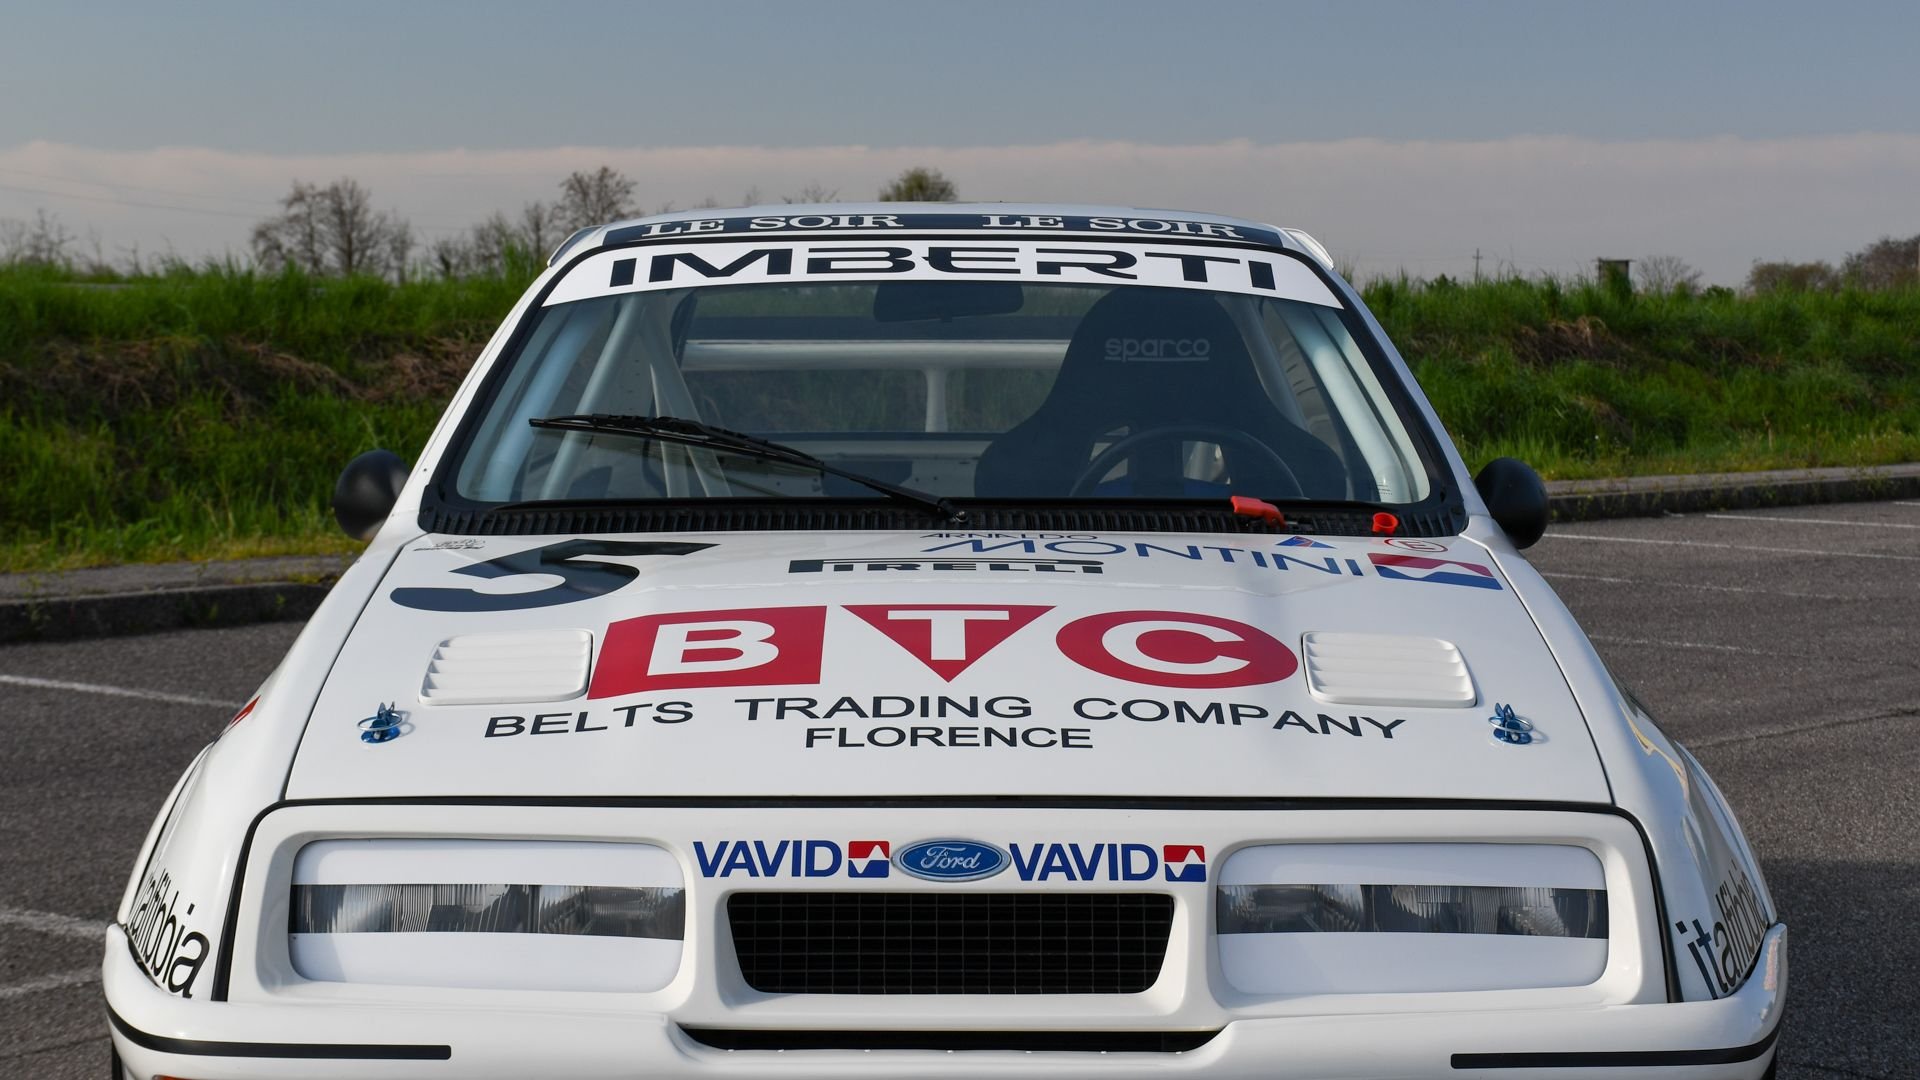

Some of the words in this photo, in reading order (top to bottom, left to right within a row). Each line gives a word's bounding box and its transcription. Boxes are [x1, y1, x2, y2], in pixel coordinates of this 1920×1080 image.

[642, 219, 724, 238] LE
[750, 215, 904, 230] SOIR
[982, 215, 1064, 228] LE
[1089, 218, 1244, 239] SOIR
[609, 246, 1276, 290] IMBERTI
[1105, 338, 1210, 362] sparco
[788, 557, 1104, 574] PIRELLI
[920, 539, 1364, 577] MONTINI
[389, 539, 721, 612] 5
[484, 701, 694, 738] BELTS
[735, 696, 1032, 720] TRADING
[1073, 697, 1406, 740] COMPANY
[806, 727, 1093, 748] FLORENCE
[692, 840, 842, 878] VAVID
[920, 847, 980, 873] Ford
[1009, 843, 1158, 881] VAVID
